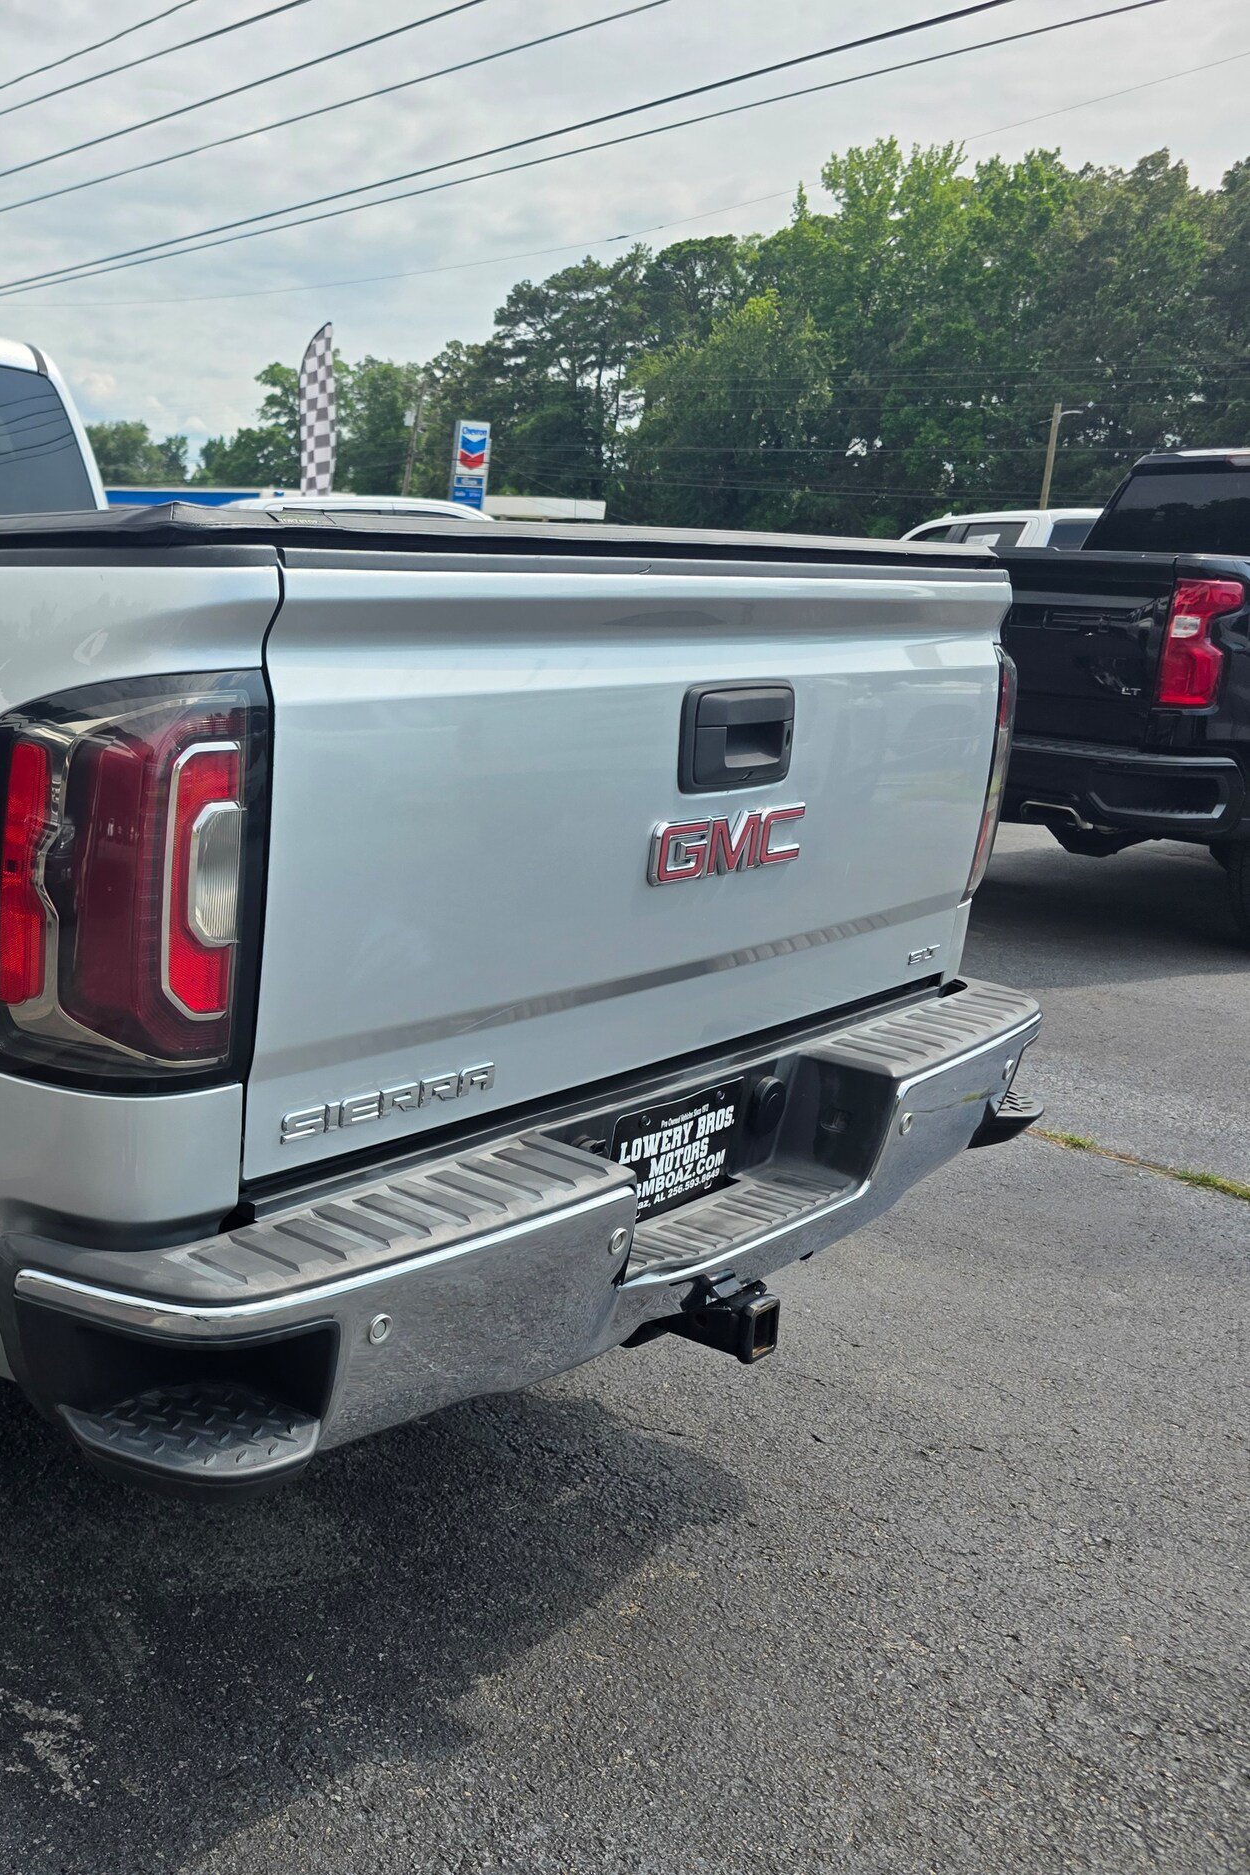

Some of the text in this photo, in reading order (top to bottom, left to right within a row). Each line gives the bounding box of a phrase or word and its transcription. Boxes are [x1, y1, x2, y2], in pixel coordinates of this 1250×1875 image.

[1121, 687, 1142, 697] LT
[647, 802, 806, 888] GMC
[280, 1062, 495, 1145] SIERRA
[619, 1105, 735, 1165] LOWERY BROS.
[648, 1136, 710, 1179] MOTORS
[637, 1148, 726, 1199] BMBOAZ.COM
[653, 1191, 666, 1204] AL
[667, 1167, 720, 1199] 256.593.8649
